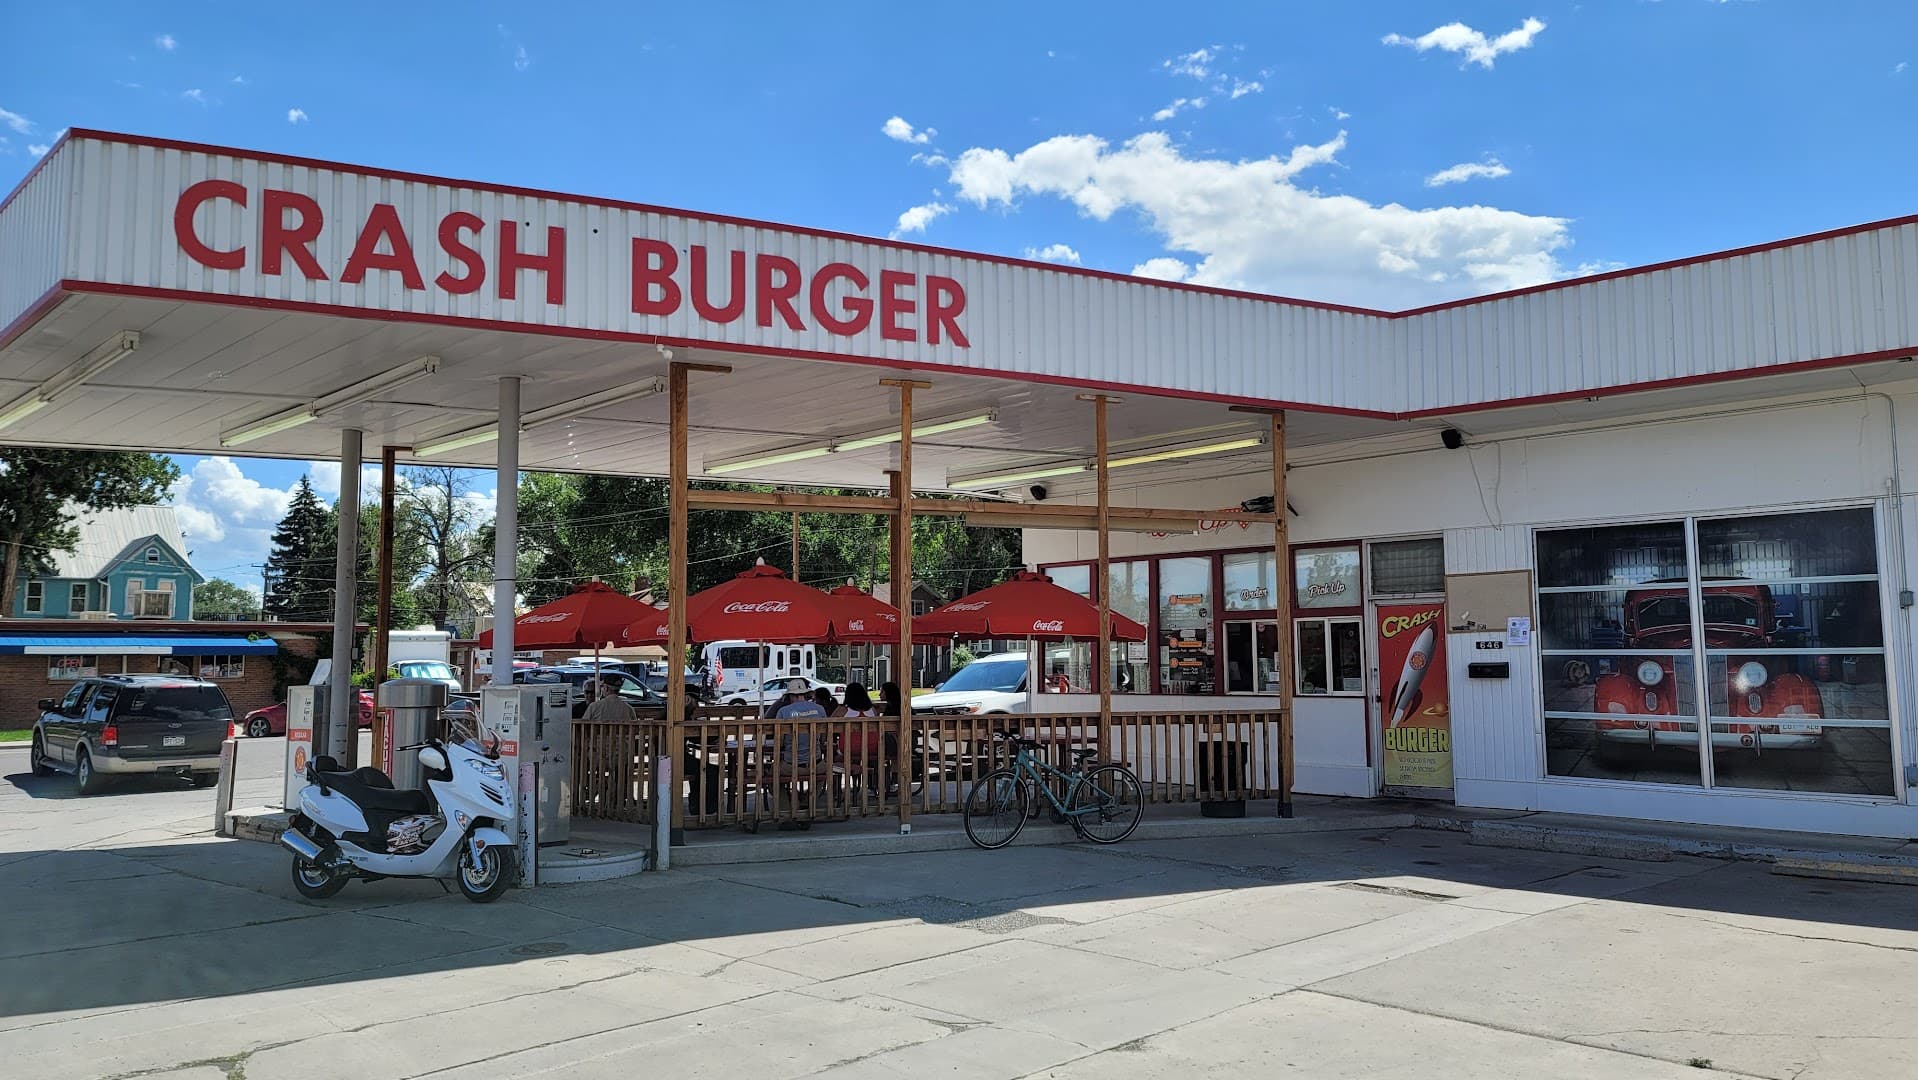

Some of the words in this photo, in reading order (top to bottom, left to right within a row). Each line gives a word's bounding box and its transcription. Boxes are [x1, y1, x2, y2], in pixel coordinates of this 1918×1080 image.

[174, 179, 565, 306] CRASH
[632, 237, 972, 348] BURGER
[1241, 587, 1268, 600] Order
[1308, 584, 1330, 598] Pick
[1331, 581, 1346, 595] Up
[724, 601, 792, 614] Coca-Cola
[1033, 619, 1064, 631] Coca-Cola
[1381, 608, 1442, 639] CRASH
[1479, 641, 1501, 650] 646
[382, 713, 391, 777] VACUU
[1384, 727, 1450, 752] BURGER
